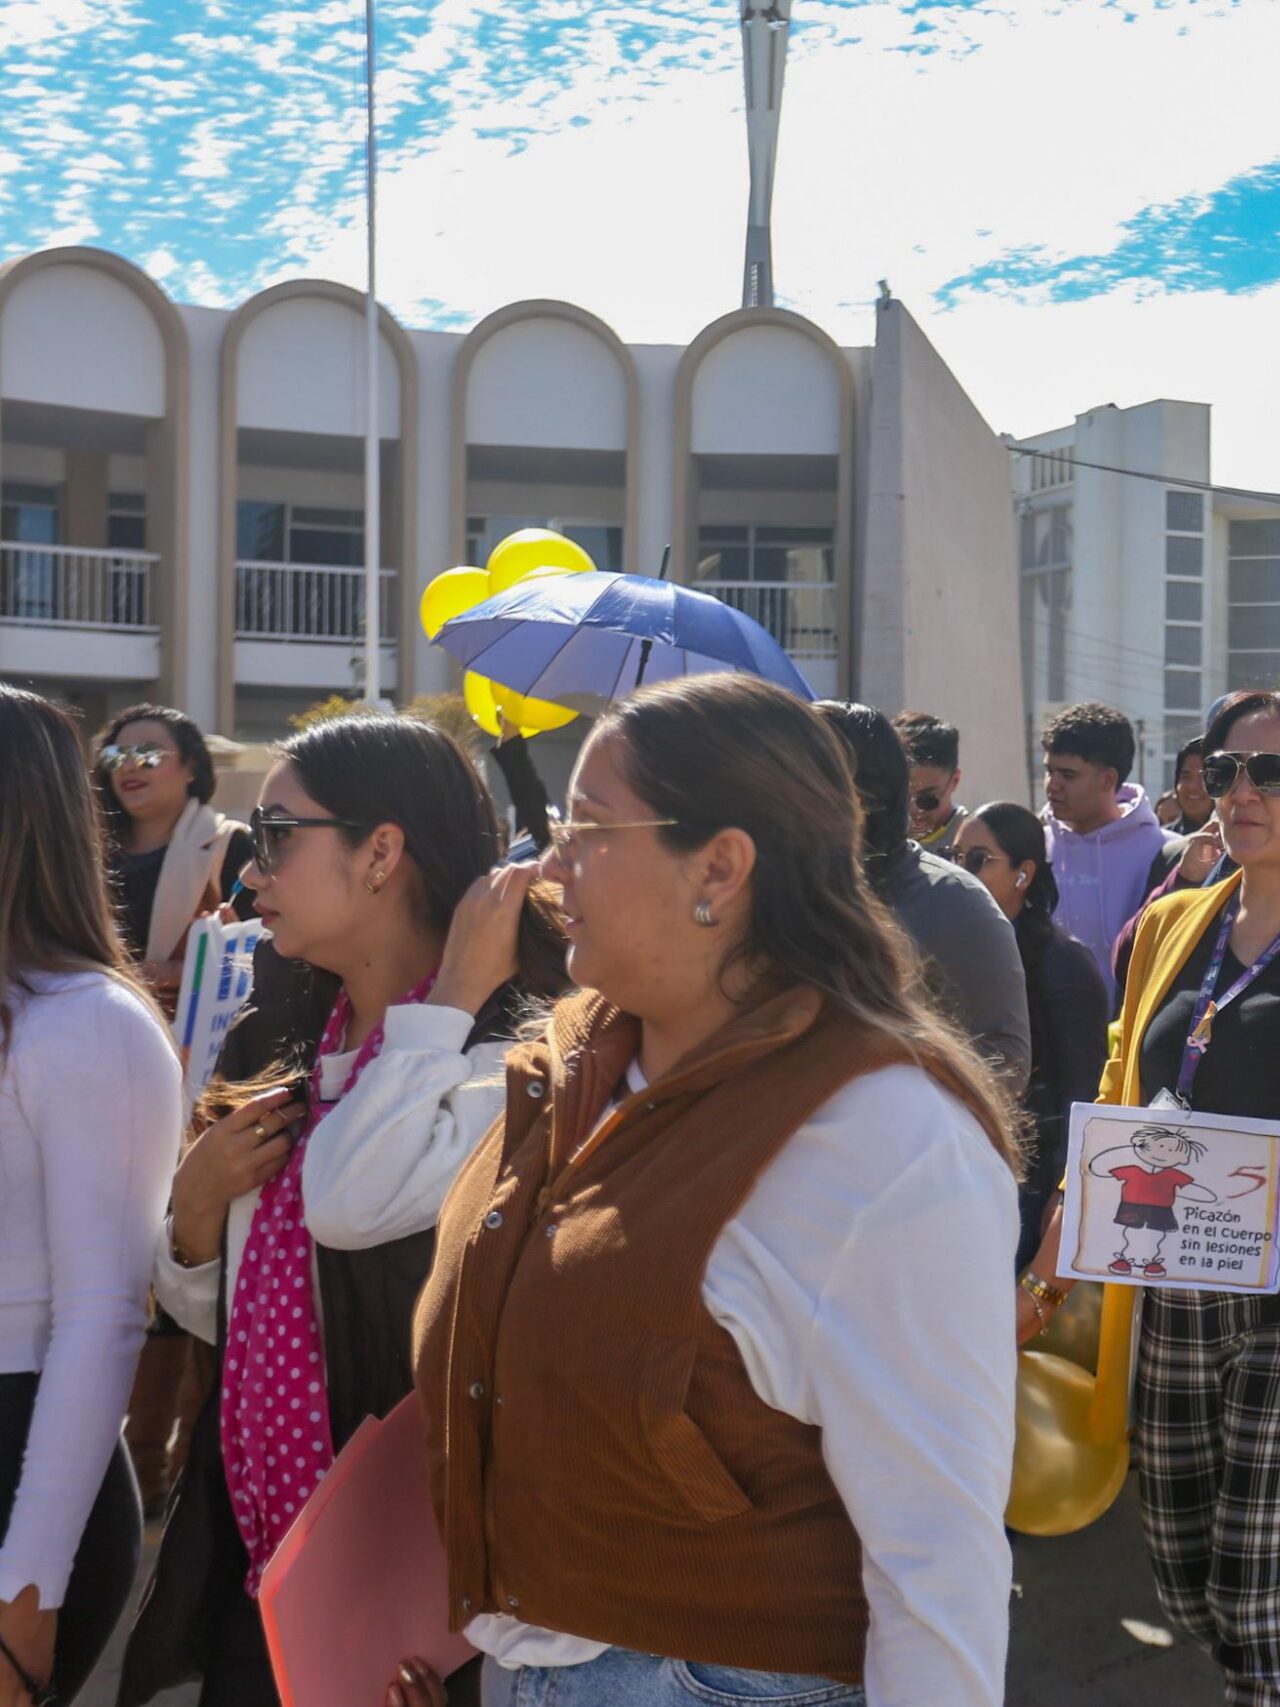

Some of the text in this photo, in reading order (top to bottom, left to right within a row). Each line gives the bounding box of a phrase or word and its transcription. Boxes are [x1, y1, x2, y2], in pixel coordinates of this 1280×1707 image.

[1227, 1166, 1267, 1199] 5
[1184, 1206, 1241, 1223] Picazón
[1182, 1224, 1200, 1235] en
[1204, 1226, 1217, 1238] el
[1180, 1239, 1262, 1257] sin lesiones
[1179, 1255, 1244, 1272] en la piel
